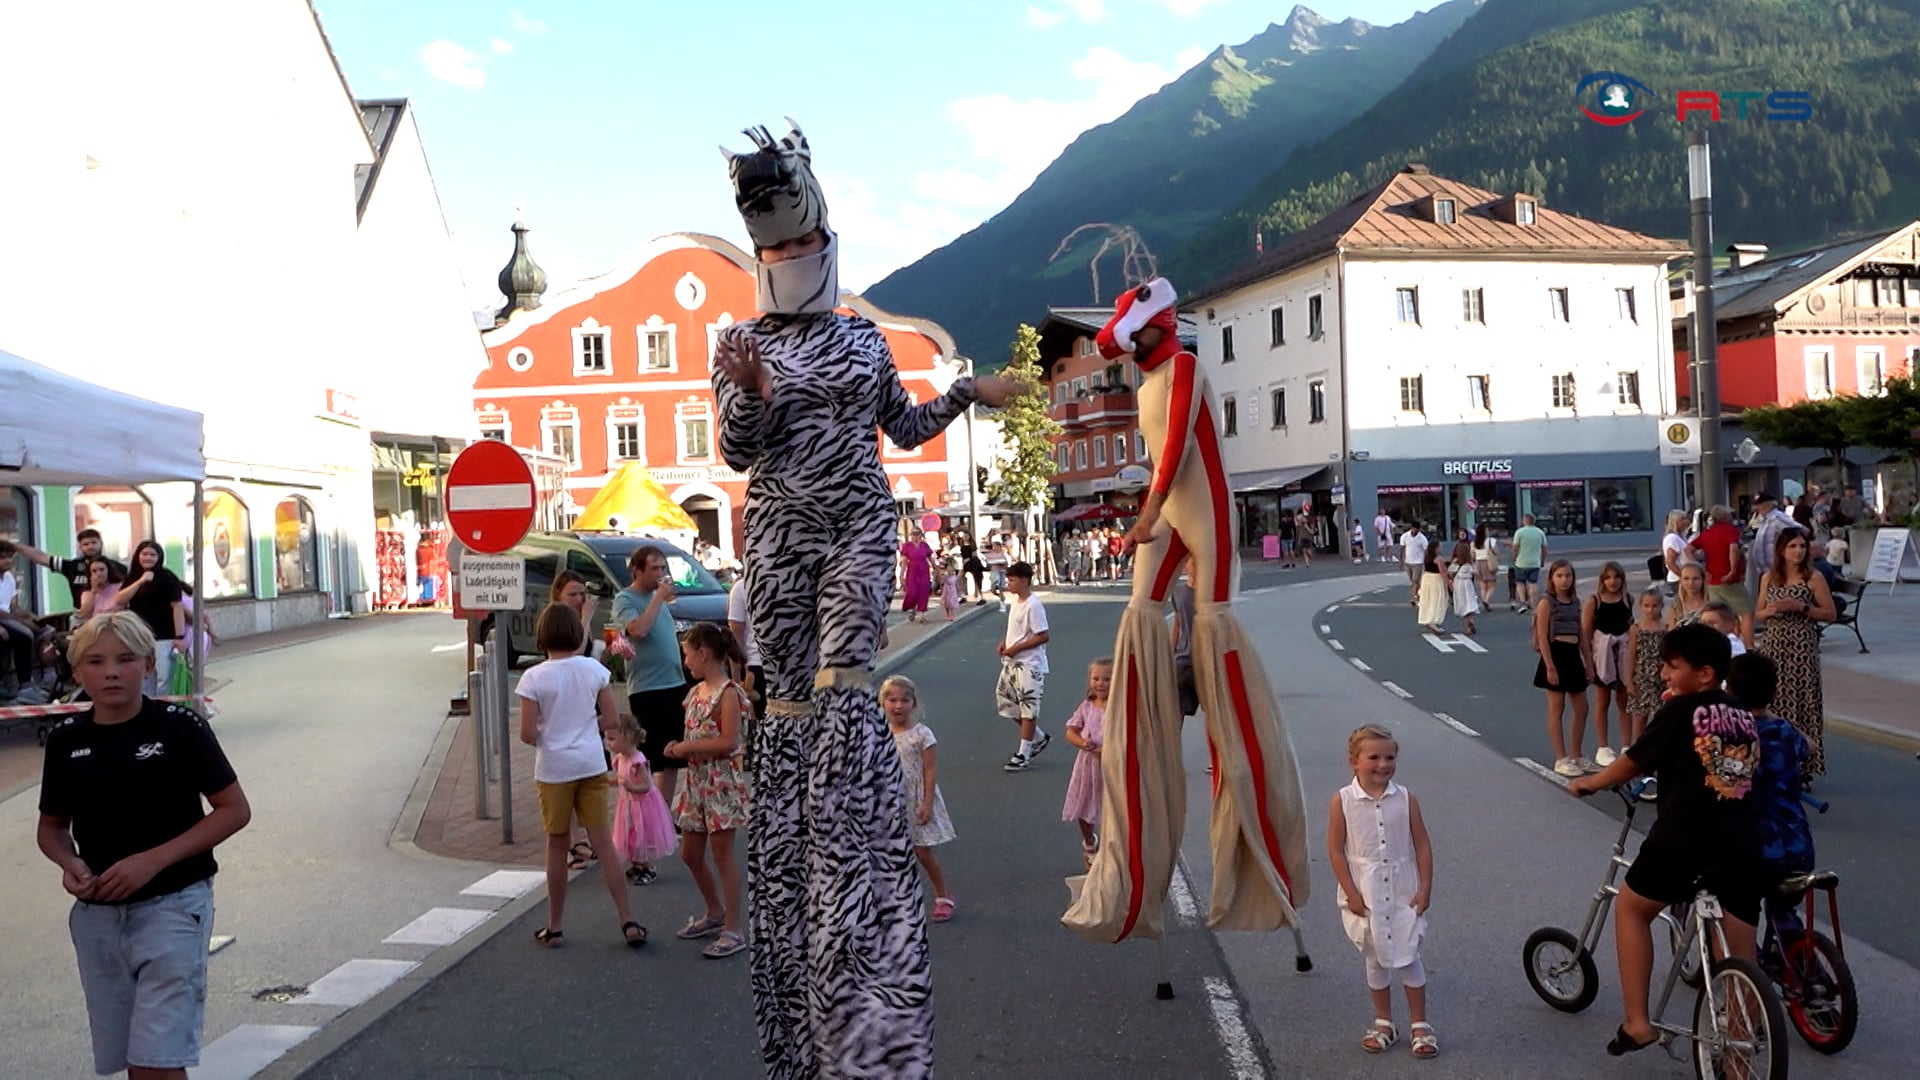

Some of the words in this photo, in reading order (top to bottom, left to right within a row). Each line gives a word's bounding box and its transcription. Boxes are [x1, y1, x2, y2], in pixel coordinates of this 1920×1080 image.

[1443, 459, 1513, 475] BREITFUSS
[462, 561, 521, 573] ausgenommen
[465, 575, 518, 589] Ladetätigkeit
[475, 591, 489, 603] mit
[491, 593, 508, 604] LKW
